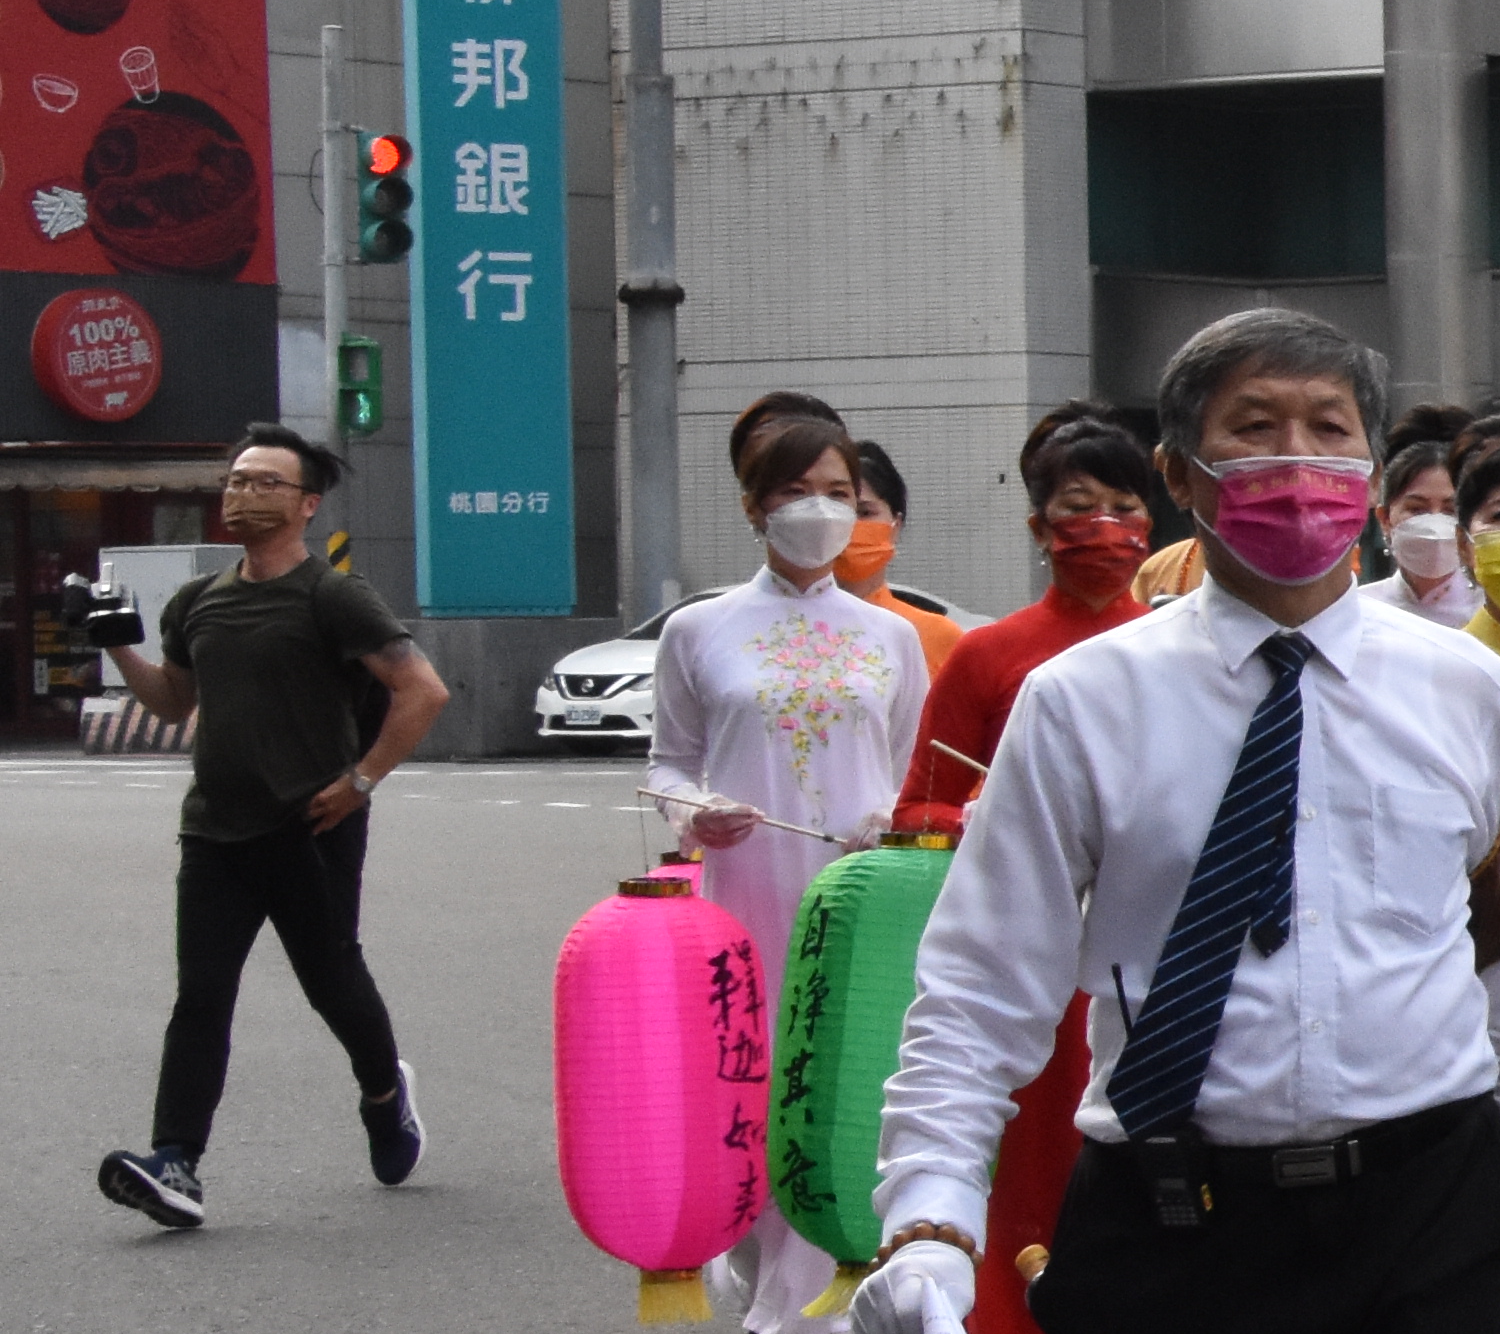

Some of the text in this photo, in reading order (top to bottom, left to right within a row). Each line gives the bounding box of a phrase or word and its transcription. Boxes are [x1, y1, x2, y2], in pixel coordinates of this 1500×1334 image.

[68, 314, 140, 347] 100%
[66, 338, 152, 376] 原肉主義
[448, 490, 551, 516] 桃園分行
[776, 892, 837, 1216] 自淨其意
